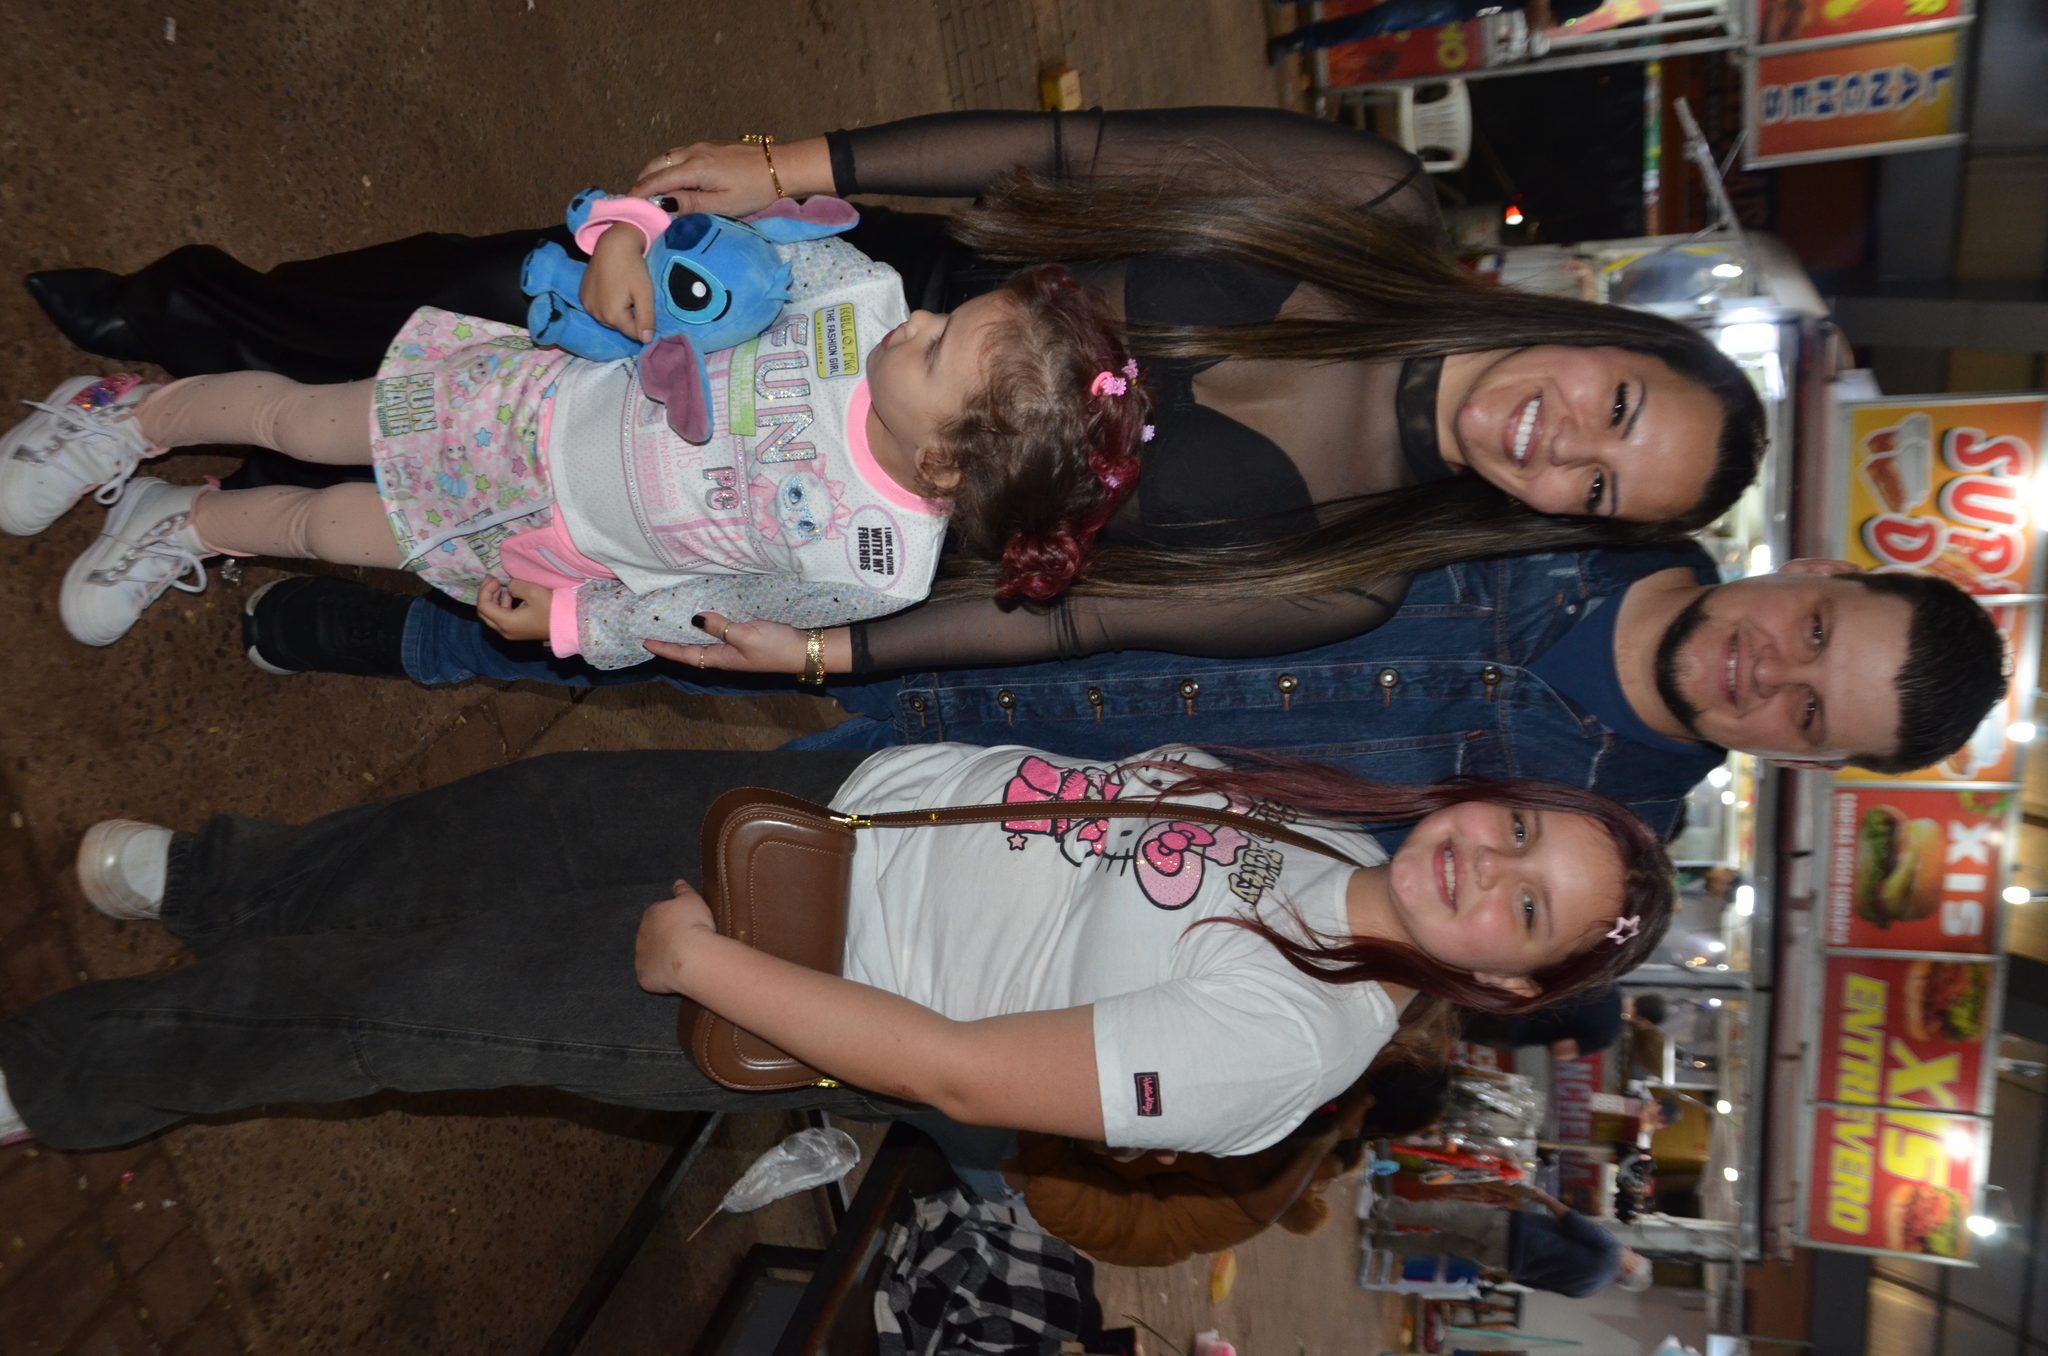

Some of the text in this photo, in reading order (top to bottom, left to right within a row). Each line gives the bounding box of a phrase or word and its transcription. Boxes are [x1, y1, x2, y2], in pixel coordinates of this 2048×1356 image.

[826, 308, 839, 375] THE FASHION GIRL
[384, 376, 412, 437] FAIR
[407, 372, 439, 432] FUN
[754, 314, 817, 464] FUN
[703, 467, 739, 510] PC
[858, 527, 871, 571] FRIENDS
[871, 527, 884, 575] WITH MY
[884, 531, 893, 547] LOVE
[886, 548, 894, 575] PLAYING
[1940, 820, 1991, 936] XIS
[1826, 973, 1888, 1236] ENTREVERO
[1880, 1038, 1961, 1187] XIS
